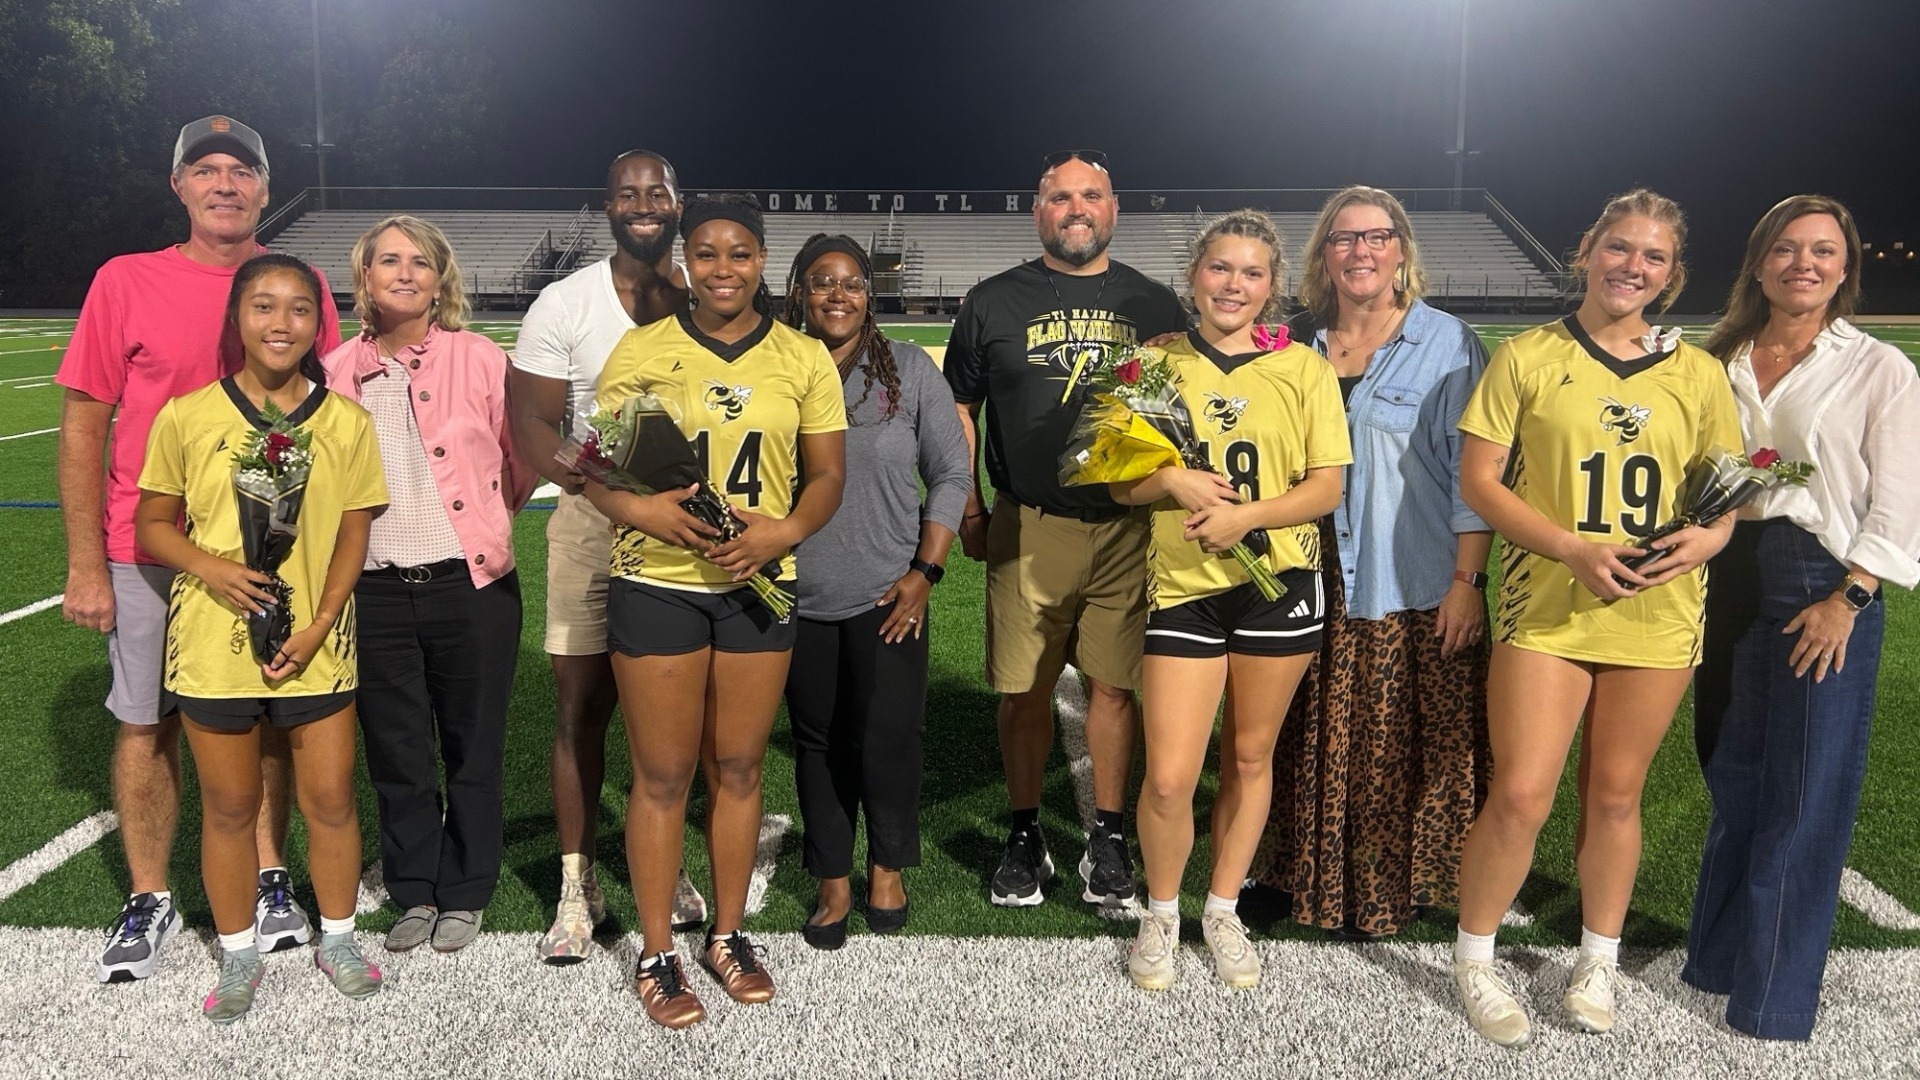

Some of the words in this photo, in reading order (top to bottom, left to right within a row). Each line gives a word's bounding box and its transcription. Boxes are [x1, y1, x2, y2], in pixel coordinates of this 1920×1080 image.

[868, 194, 905, 211] TO
[935, 194, 972, 211] TL
[1027, 320, 1067, 351] FLAG
[1067, 319, 1139, 347] FOOTBALL
[1577, 451, 1662, 538] 19
